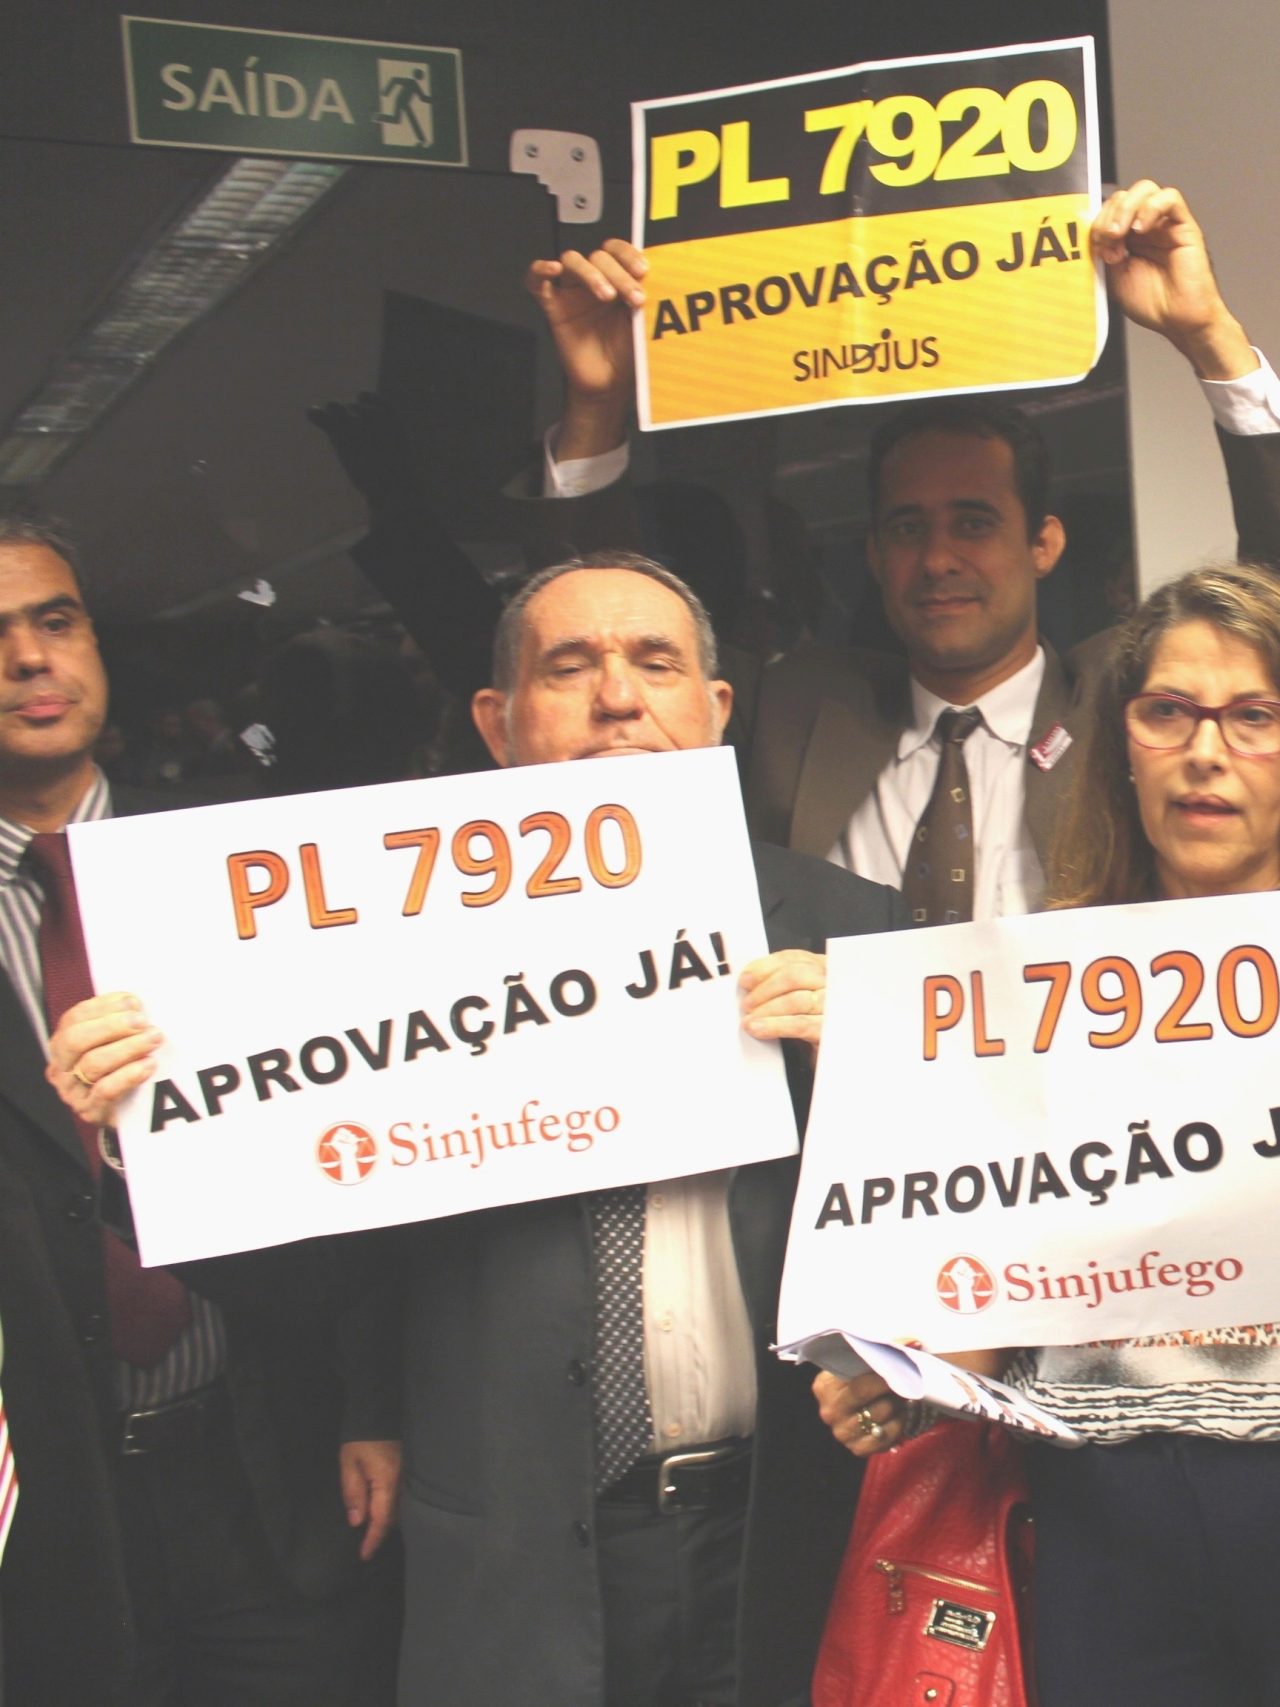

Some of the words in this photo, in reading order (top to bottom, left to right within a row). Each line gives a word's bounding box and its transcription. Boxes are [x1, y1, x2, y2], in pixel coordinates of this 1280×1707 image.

[160, 56, 355, 124] SAÍDA
[649, 120, 790, 220] PL
[804, 79, 1077, 195] 7920
[651, 239, 980, 340] APROVAÇÃO
[996, 216, 1082, 272] JÁ!
[227, 843, 358, 940] PL
[384, 803, 642, 917] 7920
[149, 968, 598, 1133] APROVAÇÃO
[624, 929, 732, 1001] JÁ!
[923, 970, 1006, 1061] PL
[1022, 944, 1280, 1053] 7920
[389, 1100, 621, 1169] Sinjufego
[814, 1121, 1223, 1229] APROVAÇÃO
[1006, 1251, 1244, 1308] Sinjufego
